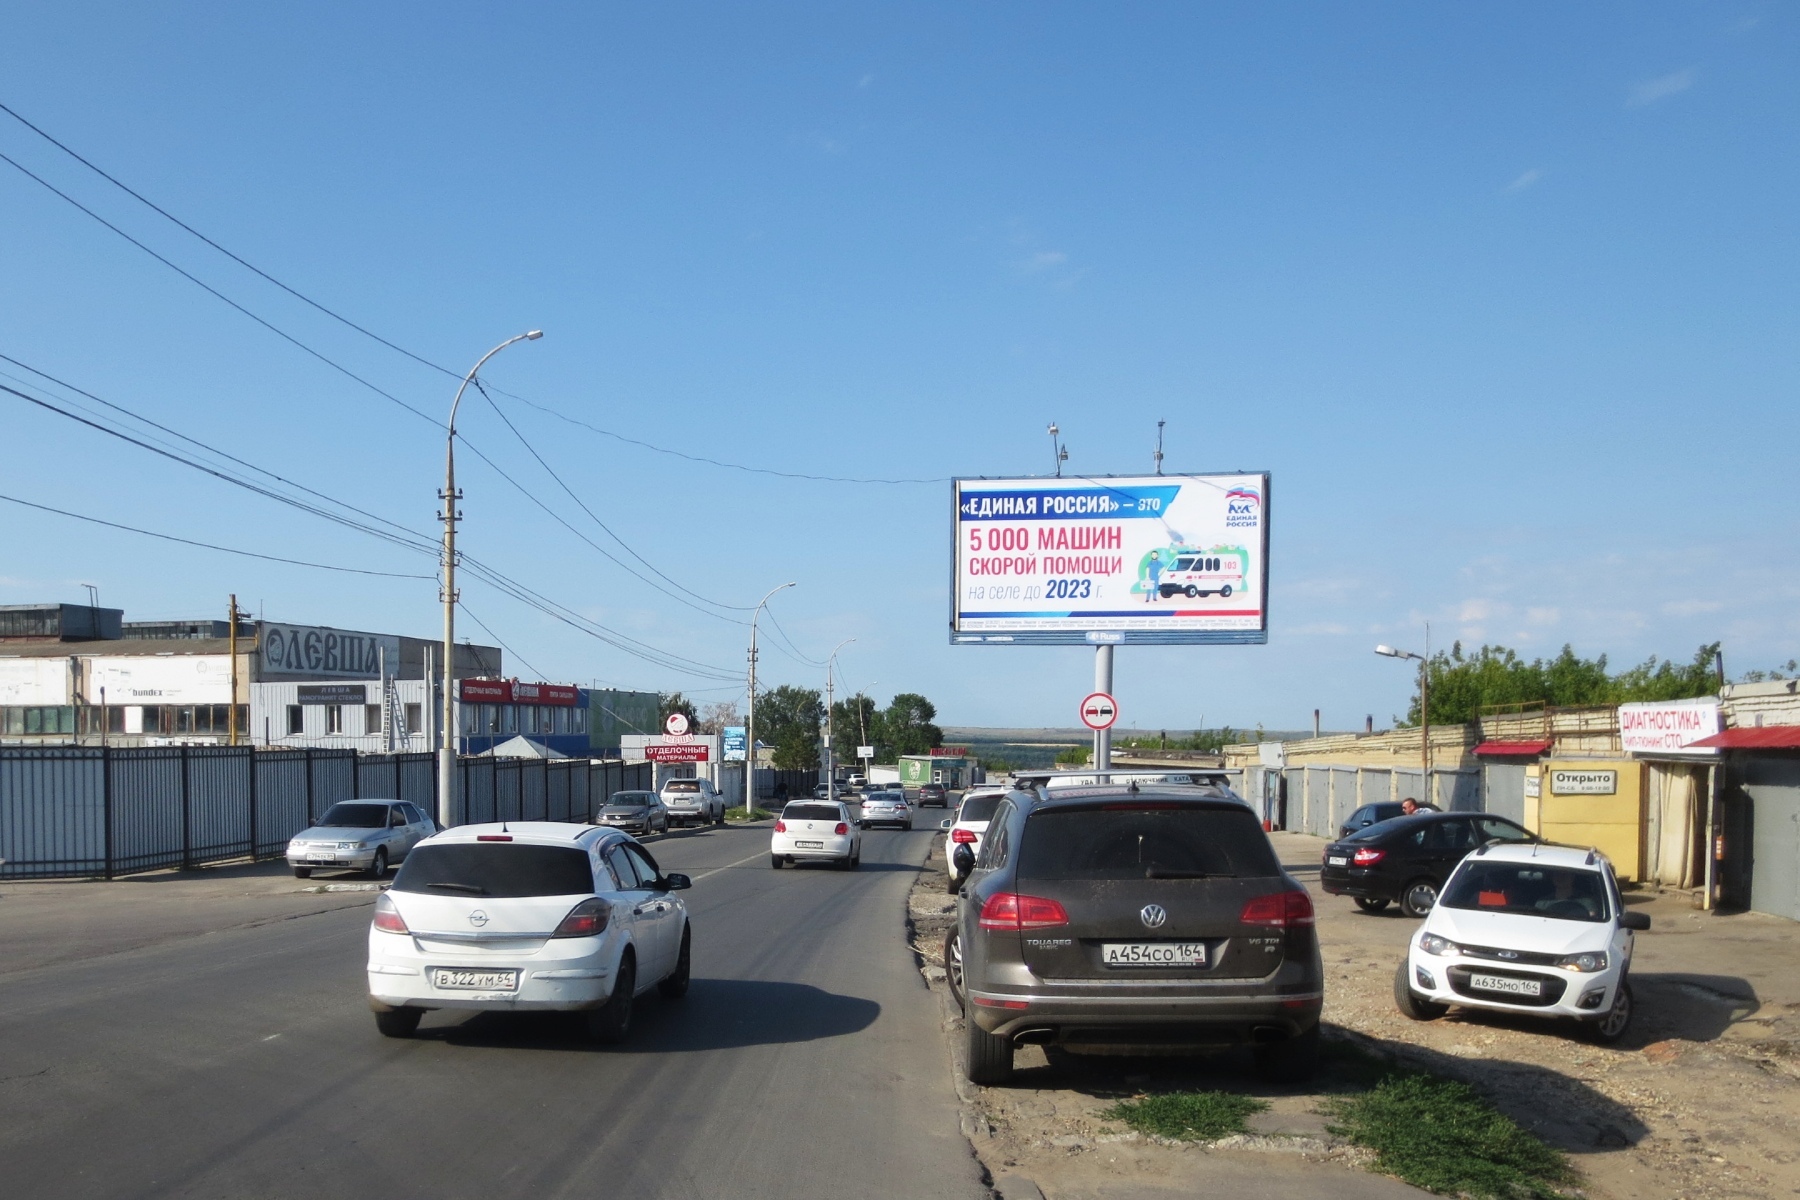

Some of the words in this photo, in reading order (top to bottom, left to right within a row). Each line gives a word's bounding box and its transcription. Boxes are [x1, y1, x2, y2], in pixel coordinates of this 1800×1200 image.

[961, 497, 1037, 517] «ЕДИНАЯ
[1043, 495, 1119, 514] РОССИЯ»
[970, 528, 982, 551] 5
[988, 527, 1029, 551] 000
[1038, 526, 1122, 550] МАШИН
[970, 553, 1037, 576] СКОРОЙ
[1044, 556, 1122, 577] ПОМОЩИ
[1224, 561, 1237, 569] 103
[968, 586, 985, 599] на
[989, 586, 1020, 600] селе
[1023, 585, 1041, 602] до
[1045, 579, 1092, 599] 2023
[1622, 711, 1701, 732] ДИАГНОСТИКА
[1664, 733, 1682, 748] СТО
[1556, 773, 1611, 784] Открыто
[1109, 945, 1174, 962] А454СО
[1177, 944, 1200, 957] 164
[1474, 977, 1519, 992] А635МО
[1521, 981, 1539, 991] 164
